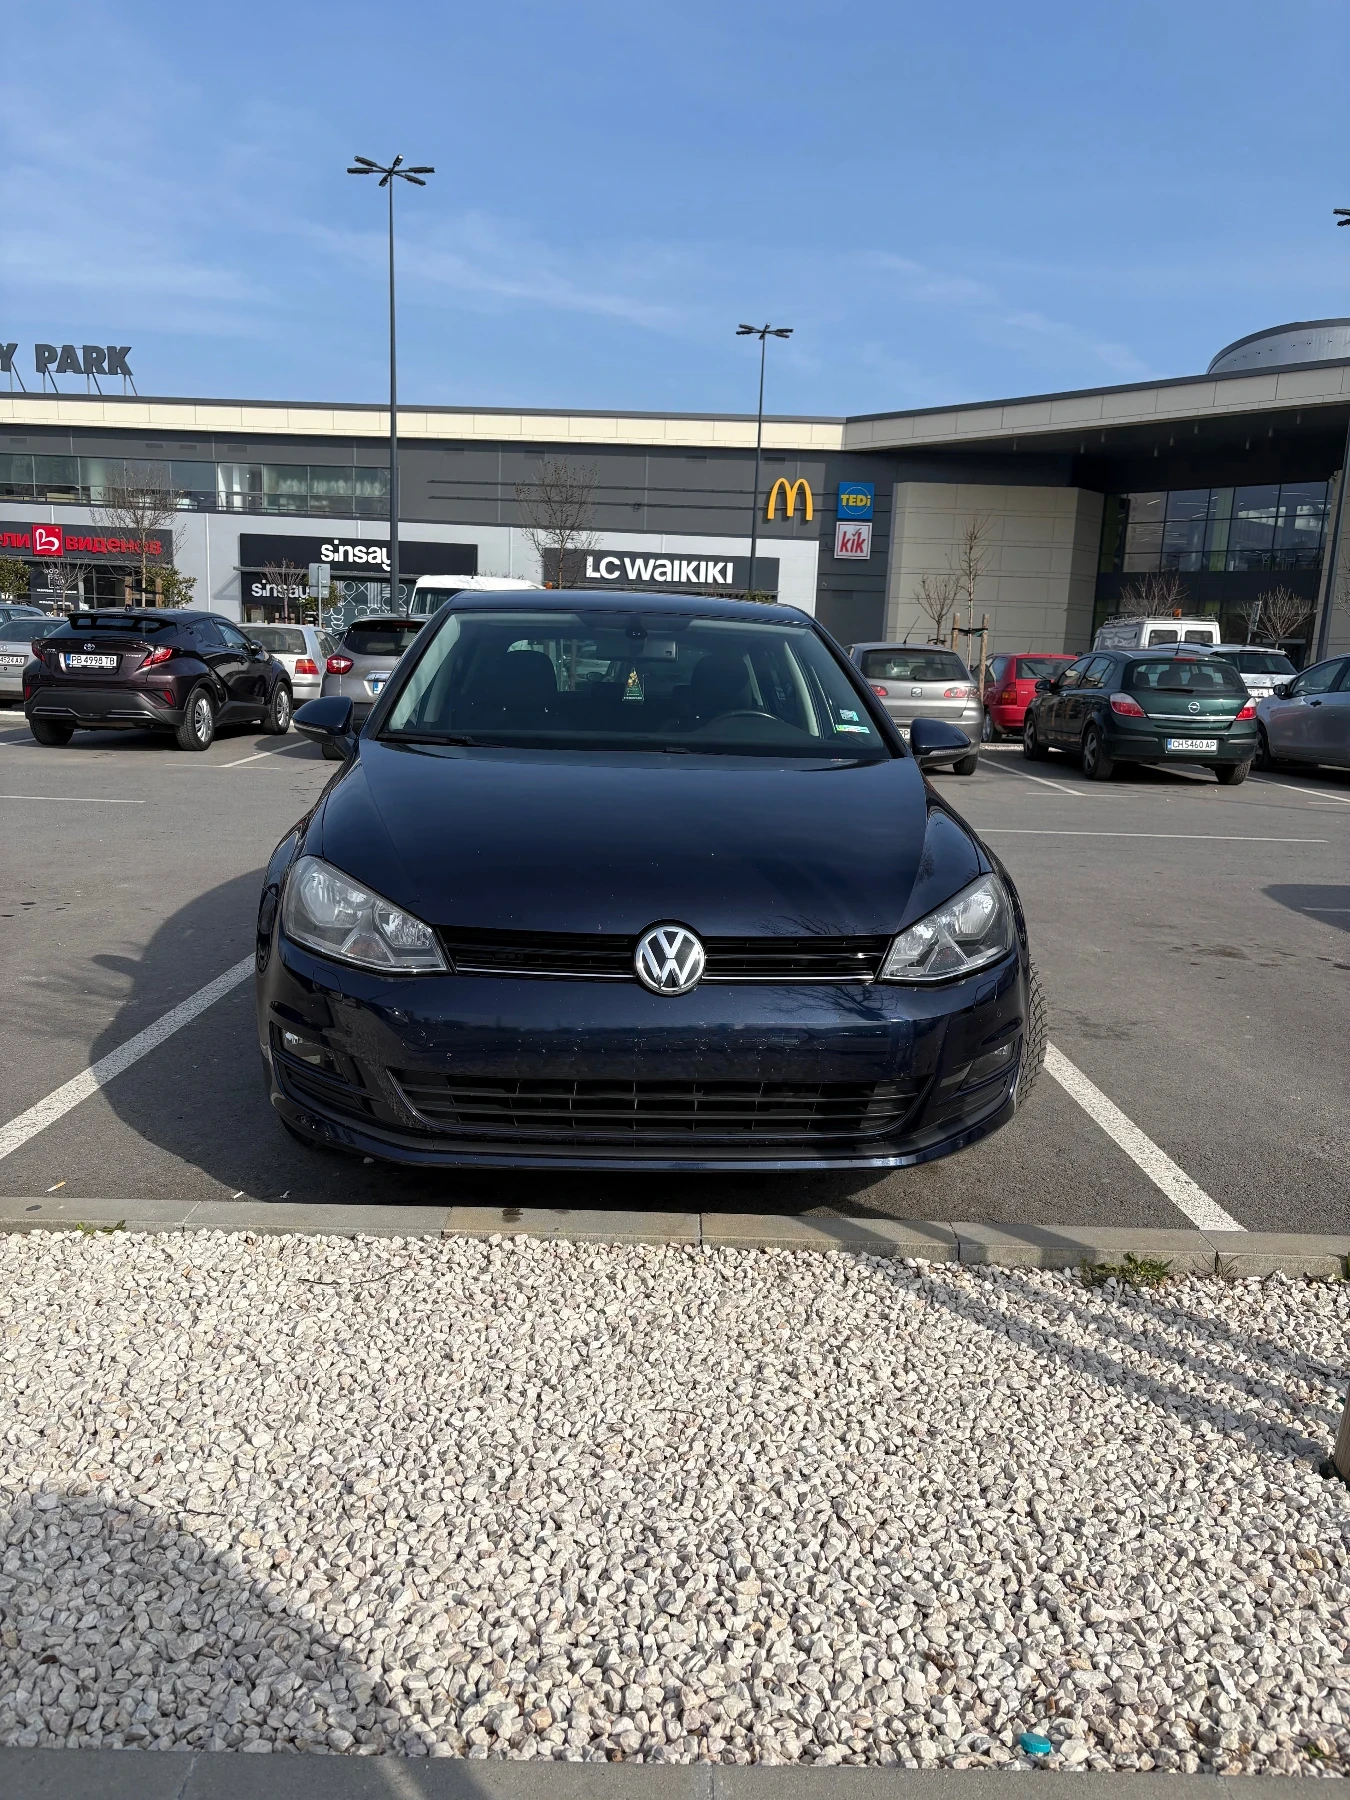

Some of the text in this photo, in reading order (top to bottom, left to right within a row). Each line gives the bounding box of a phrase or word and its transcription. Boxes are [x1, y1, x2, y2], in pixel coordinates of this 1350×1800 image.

[35, 343, 133, 376] PARK
[841, 494, 871, 507] TEDi
[321, 539, 391, 571] sinsay
[585, 555, 621, 580] LC
[84, 656, 103, 665] 4998
[1184, 740, 1204, 748] 5460
